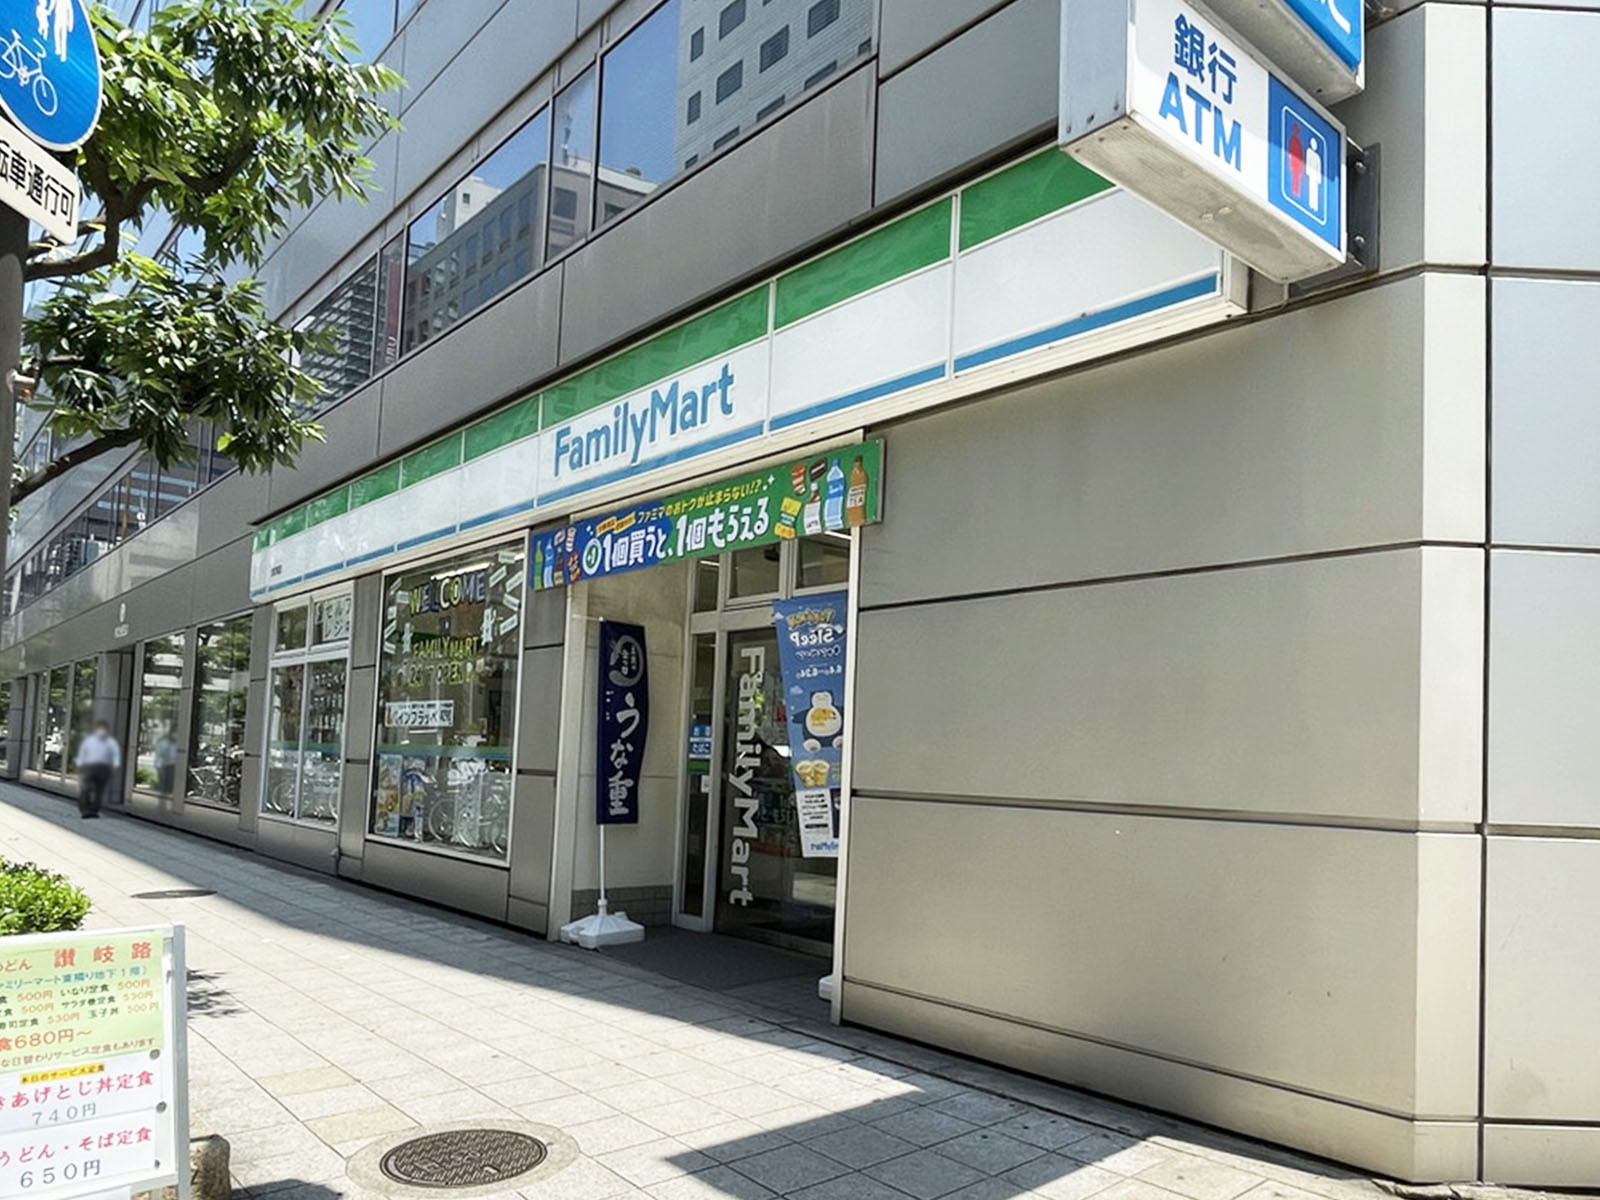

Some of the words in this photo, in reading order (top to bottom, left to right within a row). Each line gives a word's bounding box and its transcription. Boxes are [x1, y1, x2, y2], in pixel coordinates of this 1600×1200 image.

[1173, 13, 1237, 105] 銀行
[1158, 71, 1242, 172] ATM
[554, 362, 735, 477] FamilyMart
[729, 646, 765, 906] FamilyMart
[20, 1159, 101, 1189] 650円
